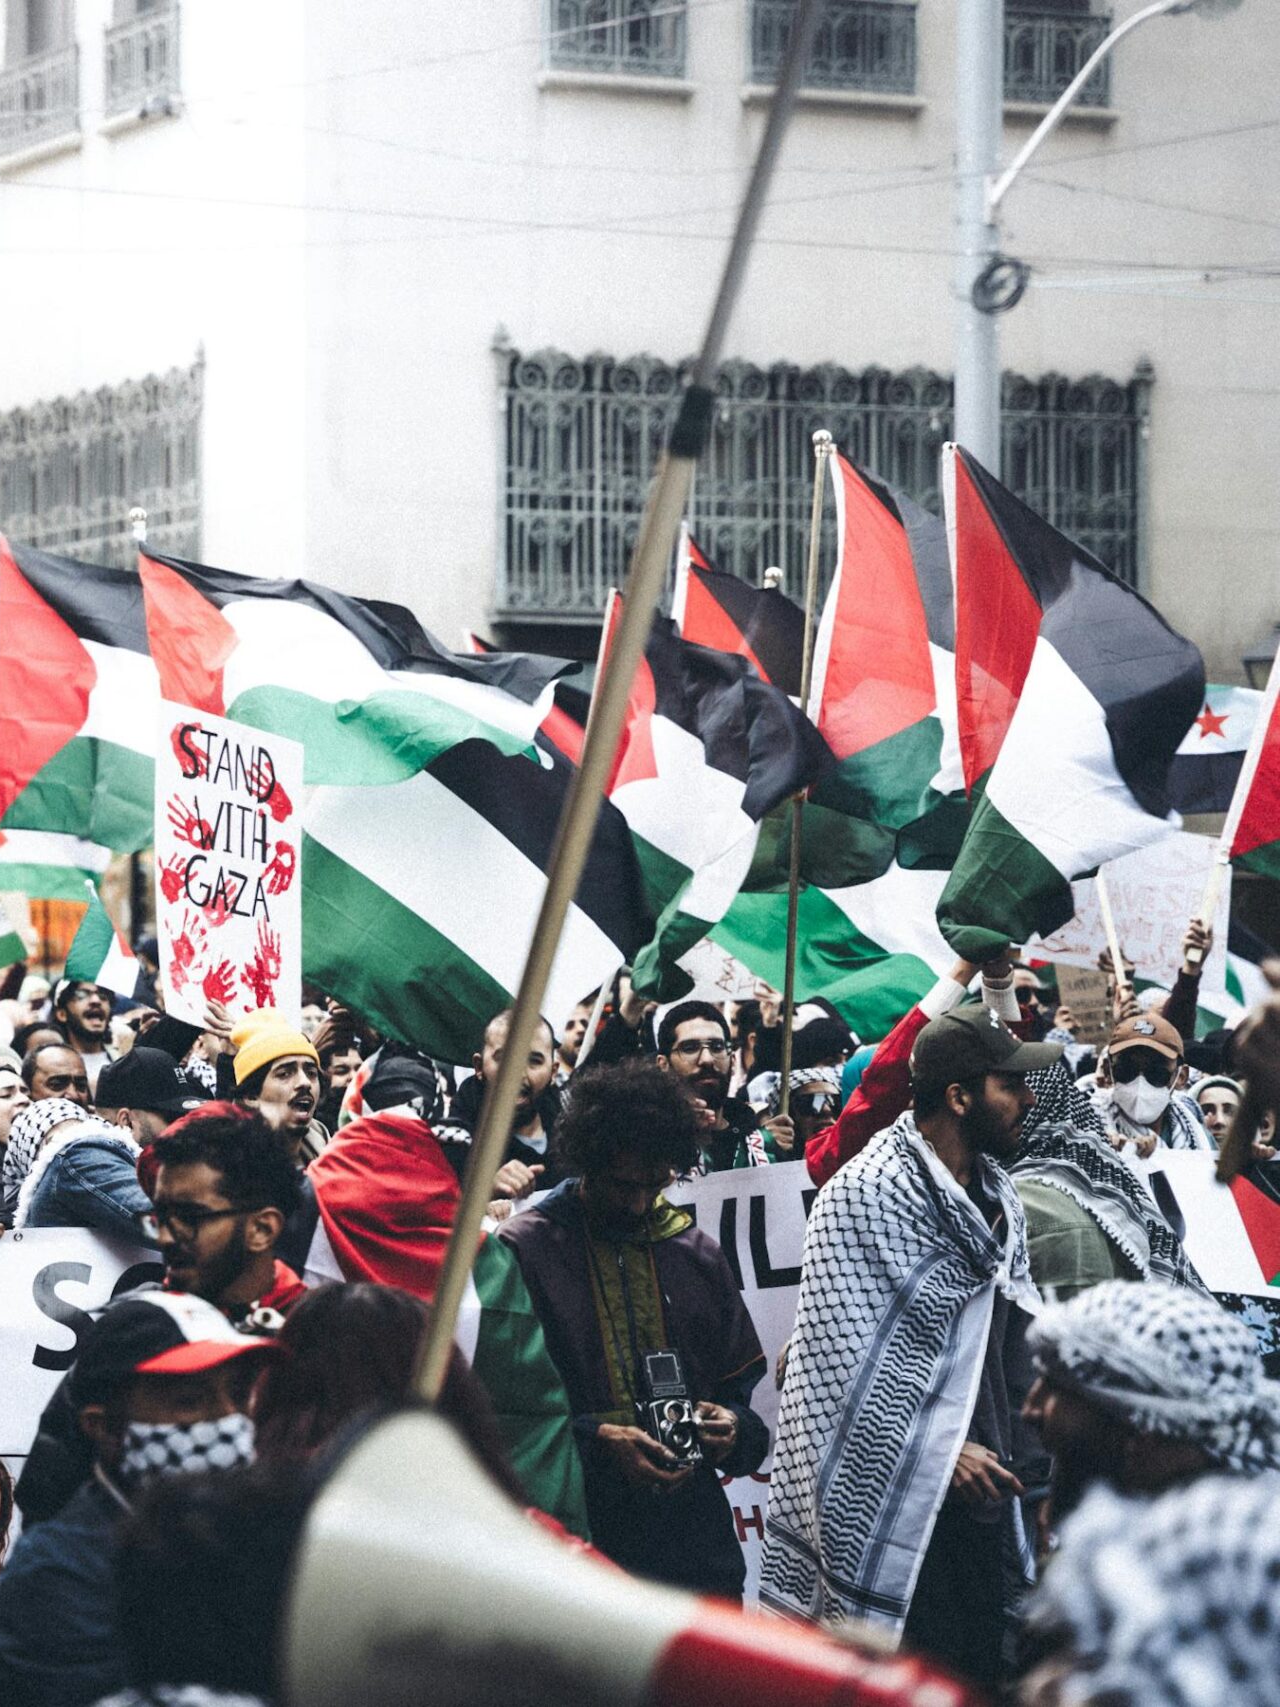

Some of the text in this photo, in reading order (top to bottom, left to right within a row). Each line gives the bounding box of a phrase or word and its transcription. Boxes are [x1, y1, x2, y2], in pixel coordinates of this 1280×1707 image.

[179, 724, 276, 804] STAND
[194, 795, 268, 864] WITH
[185, 854, 270, 922] GAZA
